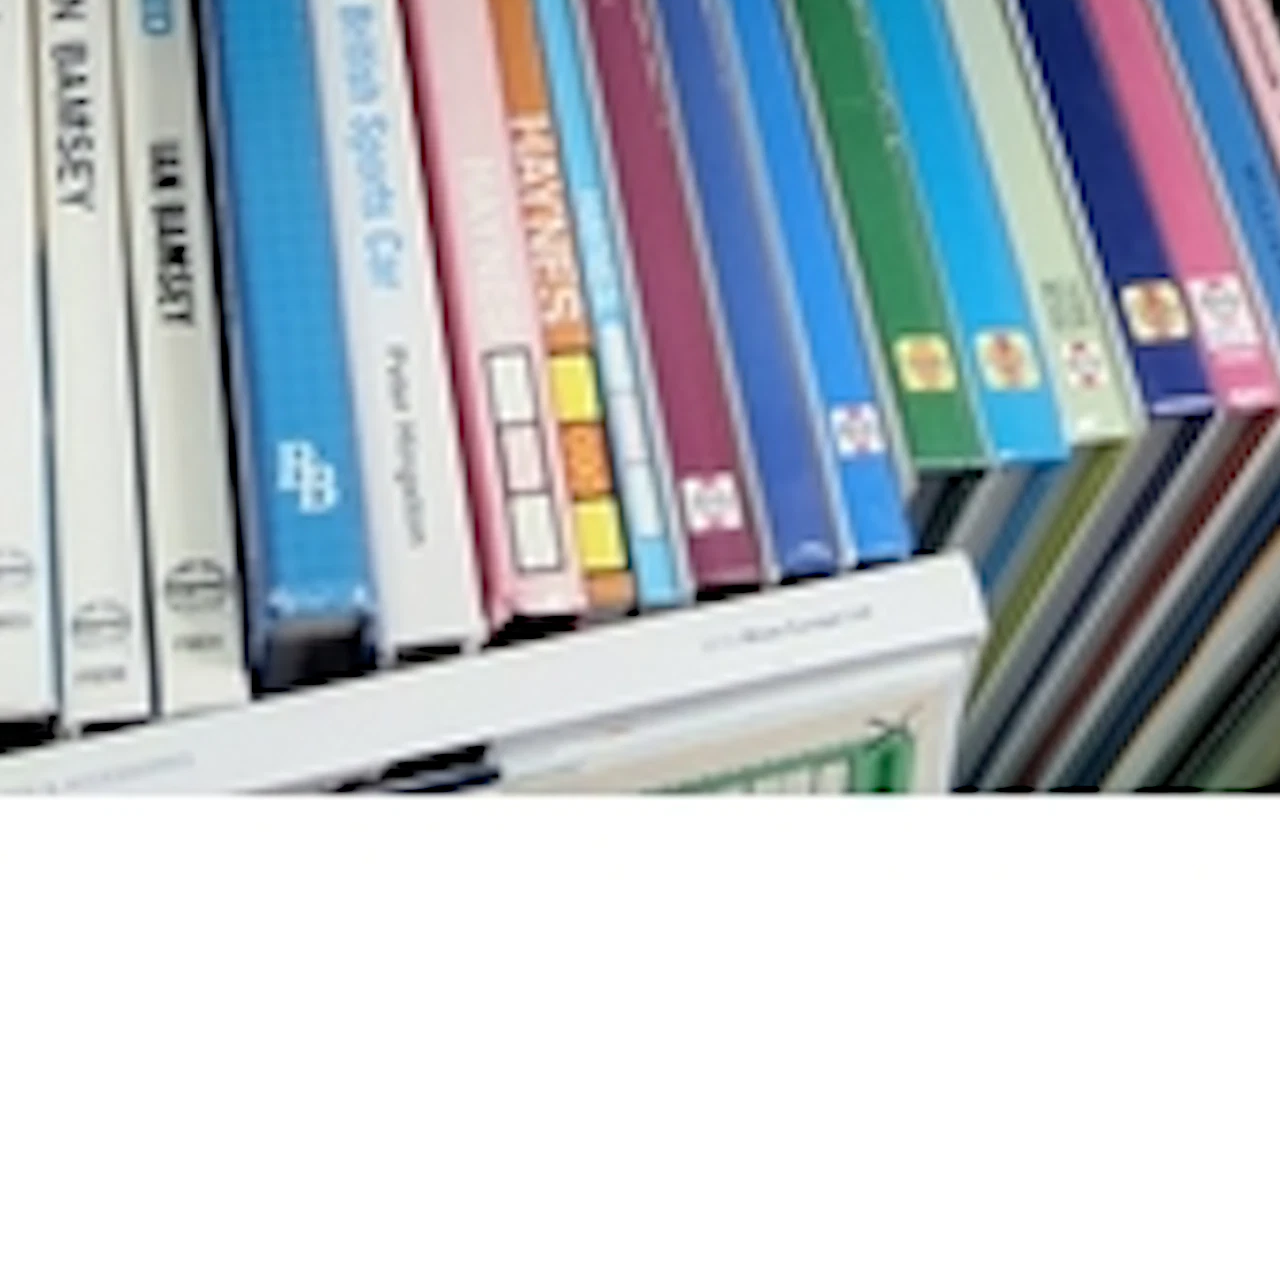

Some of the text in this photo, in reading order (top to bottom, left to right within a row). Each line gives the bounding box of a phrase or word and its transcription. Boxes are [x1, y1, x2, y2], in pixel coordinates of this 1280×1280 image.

[338, 0, 385, 106] British
[50, 41, 96, 213] BAMSEY
[148, 140, 183, 187] IAN
[346, 110, 398, 222] Sports
[363, 227, 408, 293] Car
[509, 109, 585, 327] HAYNES
